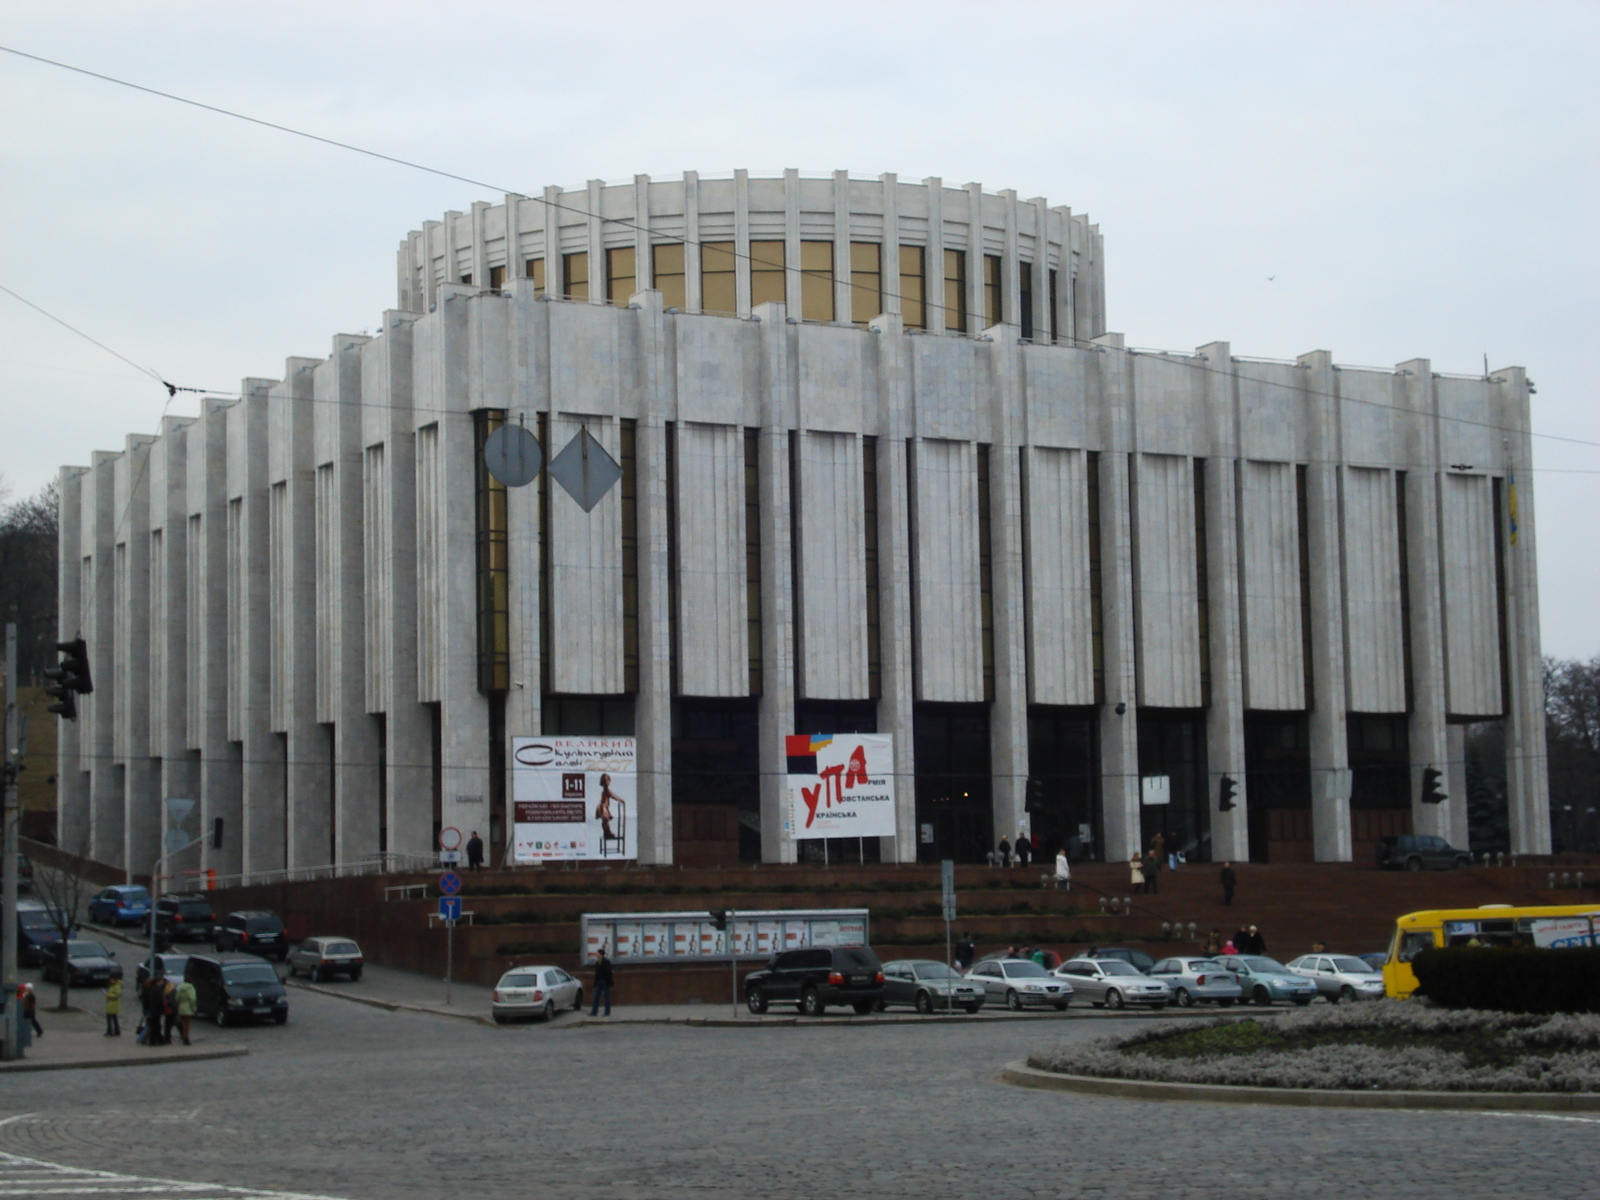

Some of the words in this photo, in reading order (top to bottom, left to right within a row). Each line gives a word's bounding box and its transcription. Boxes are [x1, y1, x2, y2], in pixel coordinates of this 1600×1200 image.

[555, 739, 633, 747] ВЕЛИКИЙ
[584, 759, 633, 771] 2007
[565, 779, 583, 791] 1-11
